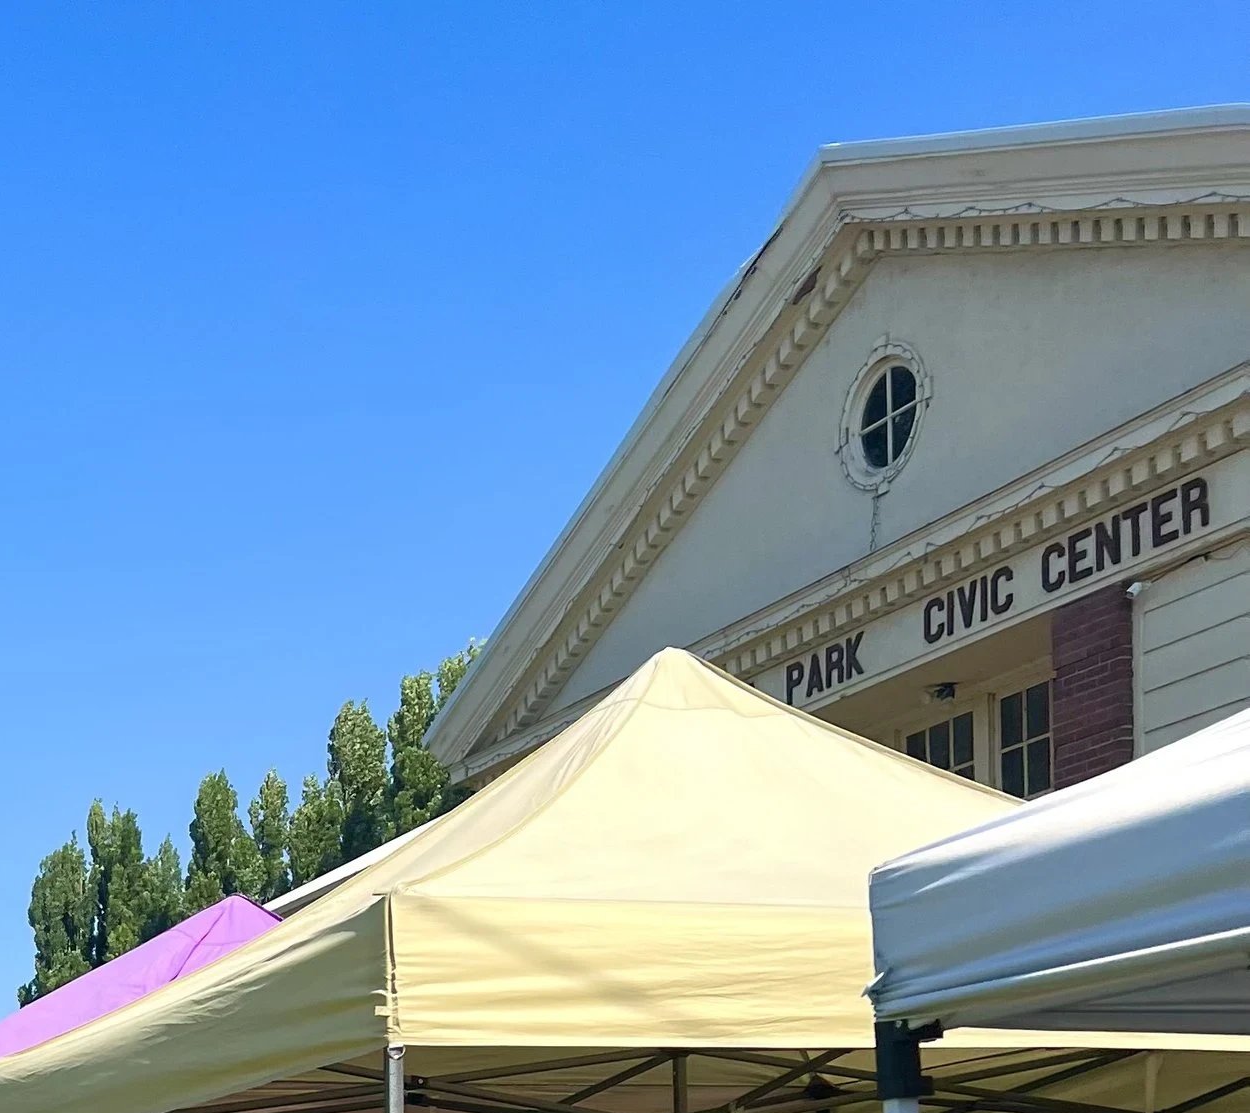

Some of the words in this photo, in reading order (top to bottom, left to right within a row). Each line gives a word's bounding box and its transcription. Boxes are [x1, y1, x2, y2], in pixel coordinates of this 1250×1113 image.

[786, 631, 865, 705] PARK
[923, 567, 1014, 644] CIVIC
[1041, 477, 1210, 593] CENTER
